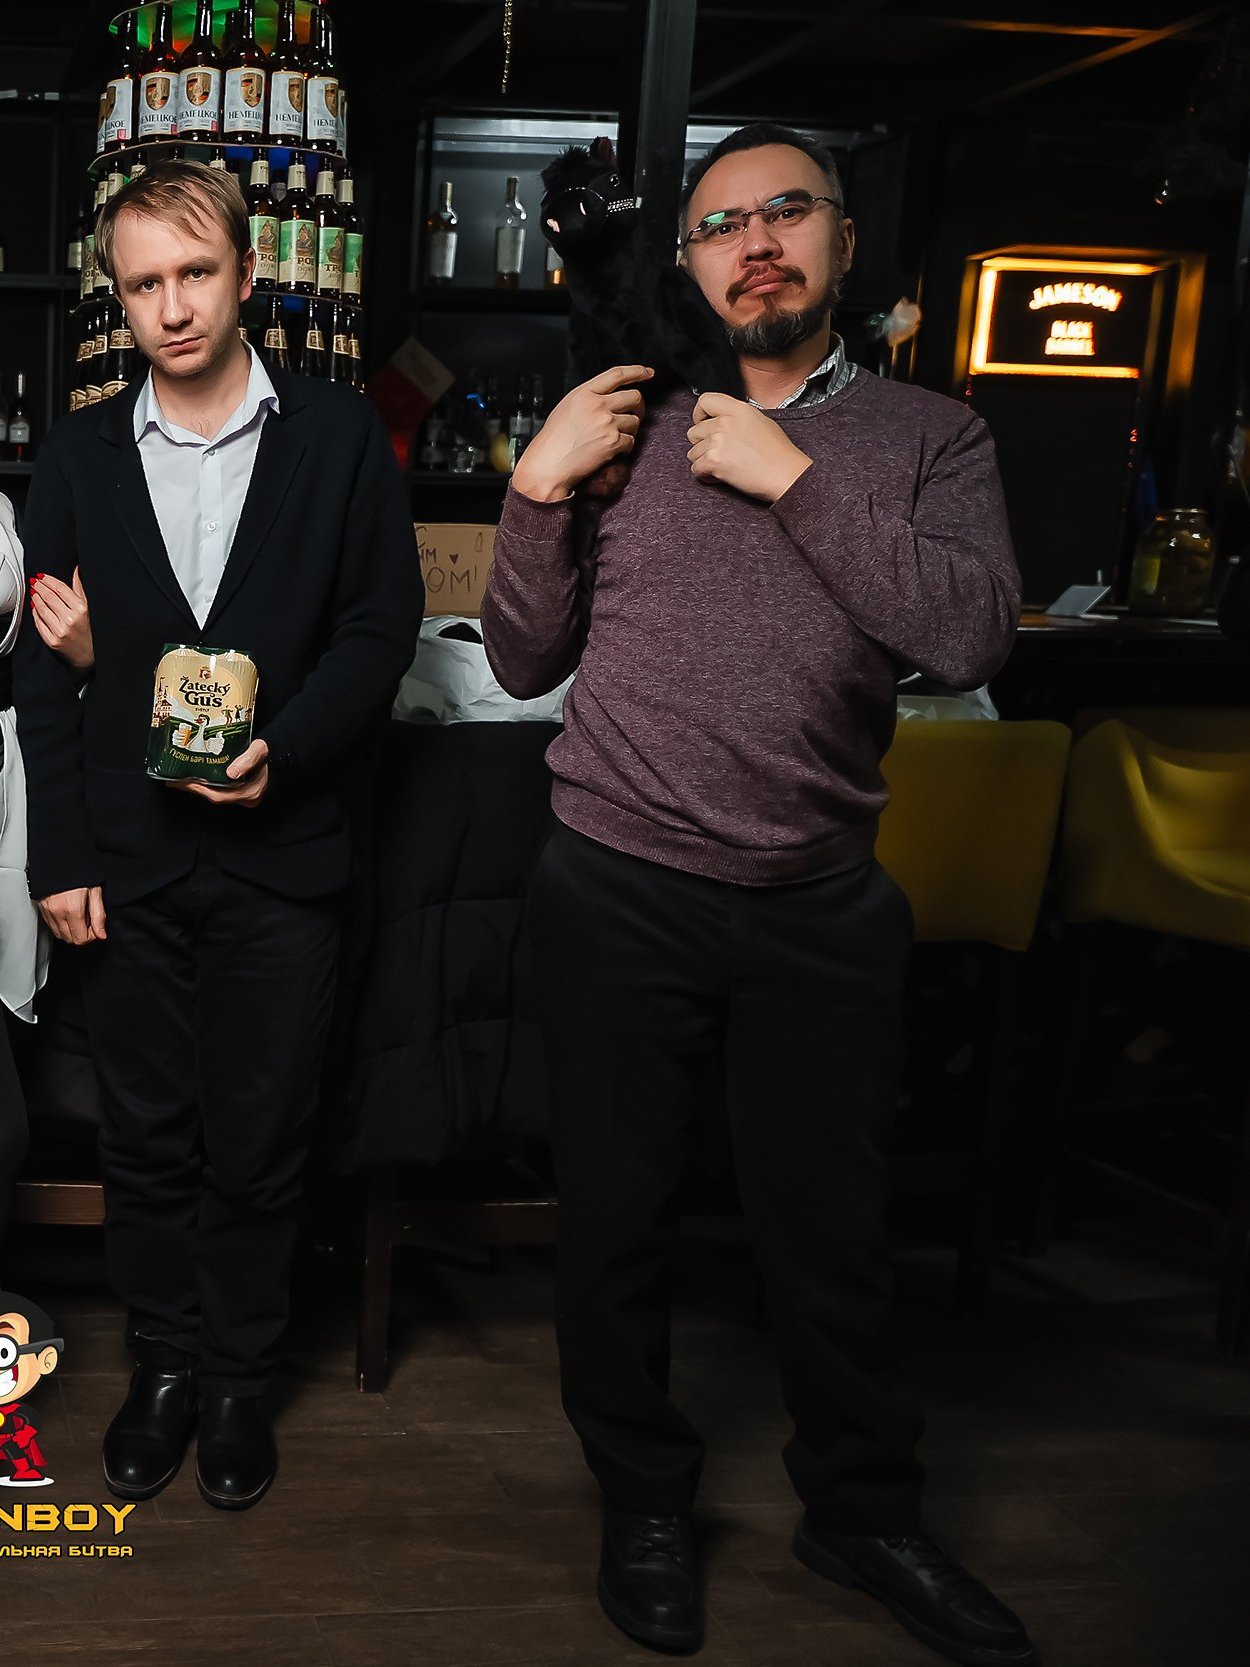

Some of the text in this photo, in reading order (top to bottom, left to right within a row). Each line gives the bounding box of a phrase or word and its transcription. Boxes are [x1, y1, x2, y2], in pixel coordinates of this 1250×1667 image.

[141, 114, 177, 124] ЕМЕЦКОЕ
[228, 110, 262, 120] НЕМЕЦК
[1029, 282, 1122, 311] JAMESON
[178, 675, 231, 696] Žatecký
[184, 690, 223, 708] Gus
